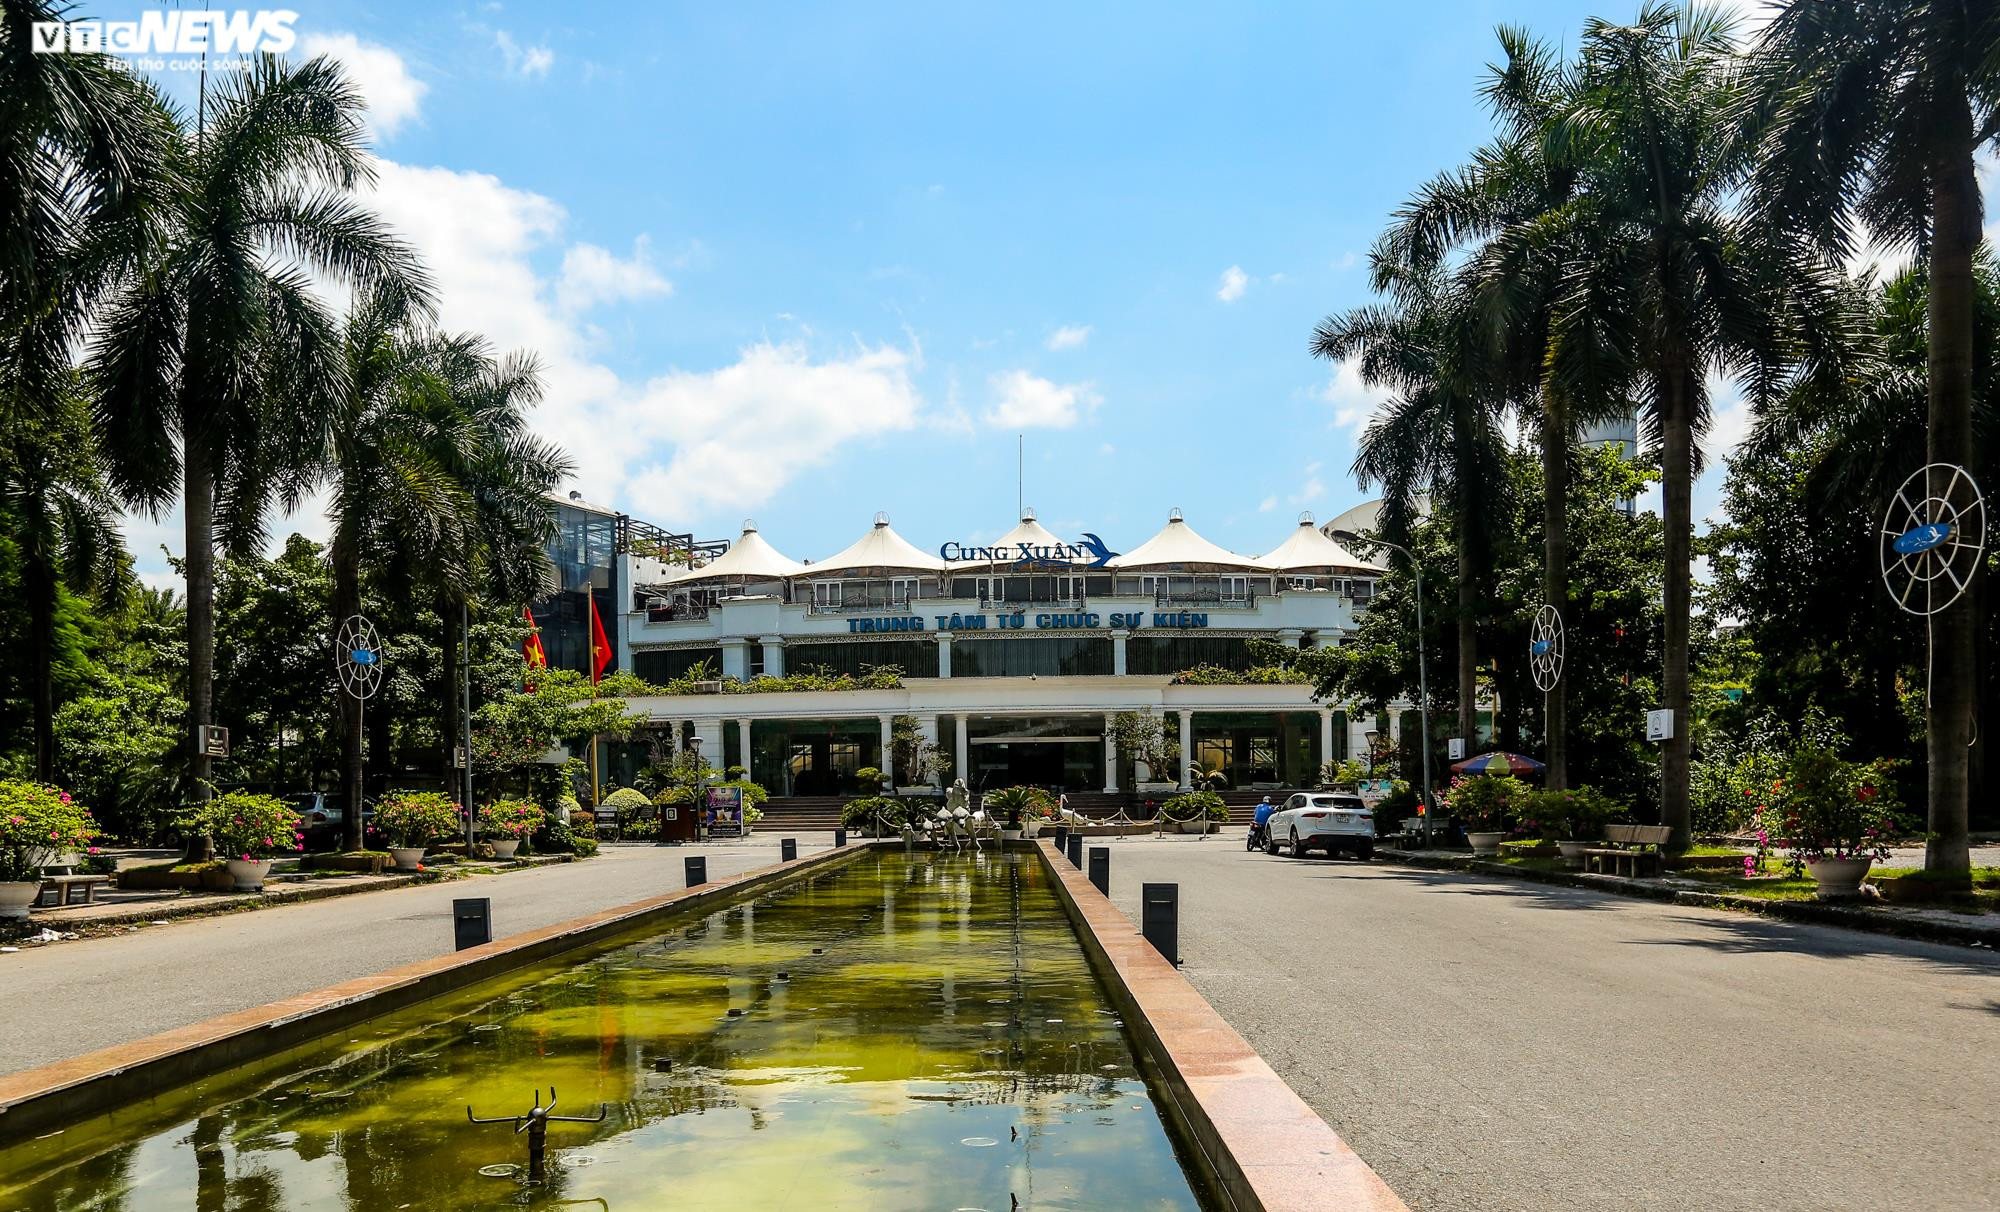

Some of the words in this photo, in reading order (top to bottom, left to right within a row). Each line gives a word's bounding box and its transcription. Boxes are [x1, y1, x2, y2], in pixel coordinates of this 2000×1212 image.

[847, 616, 924, 632] TRUNG
[935, 612, 986, 631] TÂM
[1153, 610, 1208, 630] KIỆN
